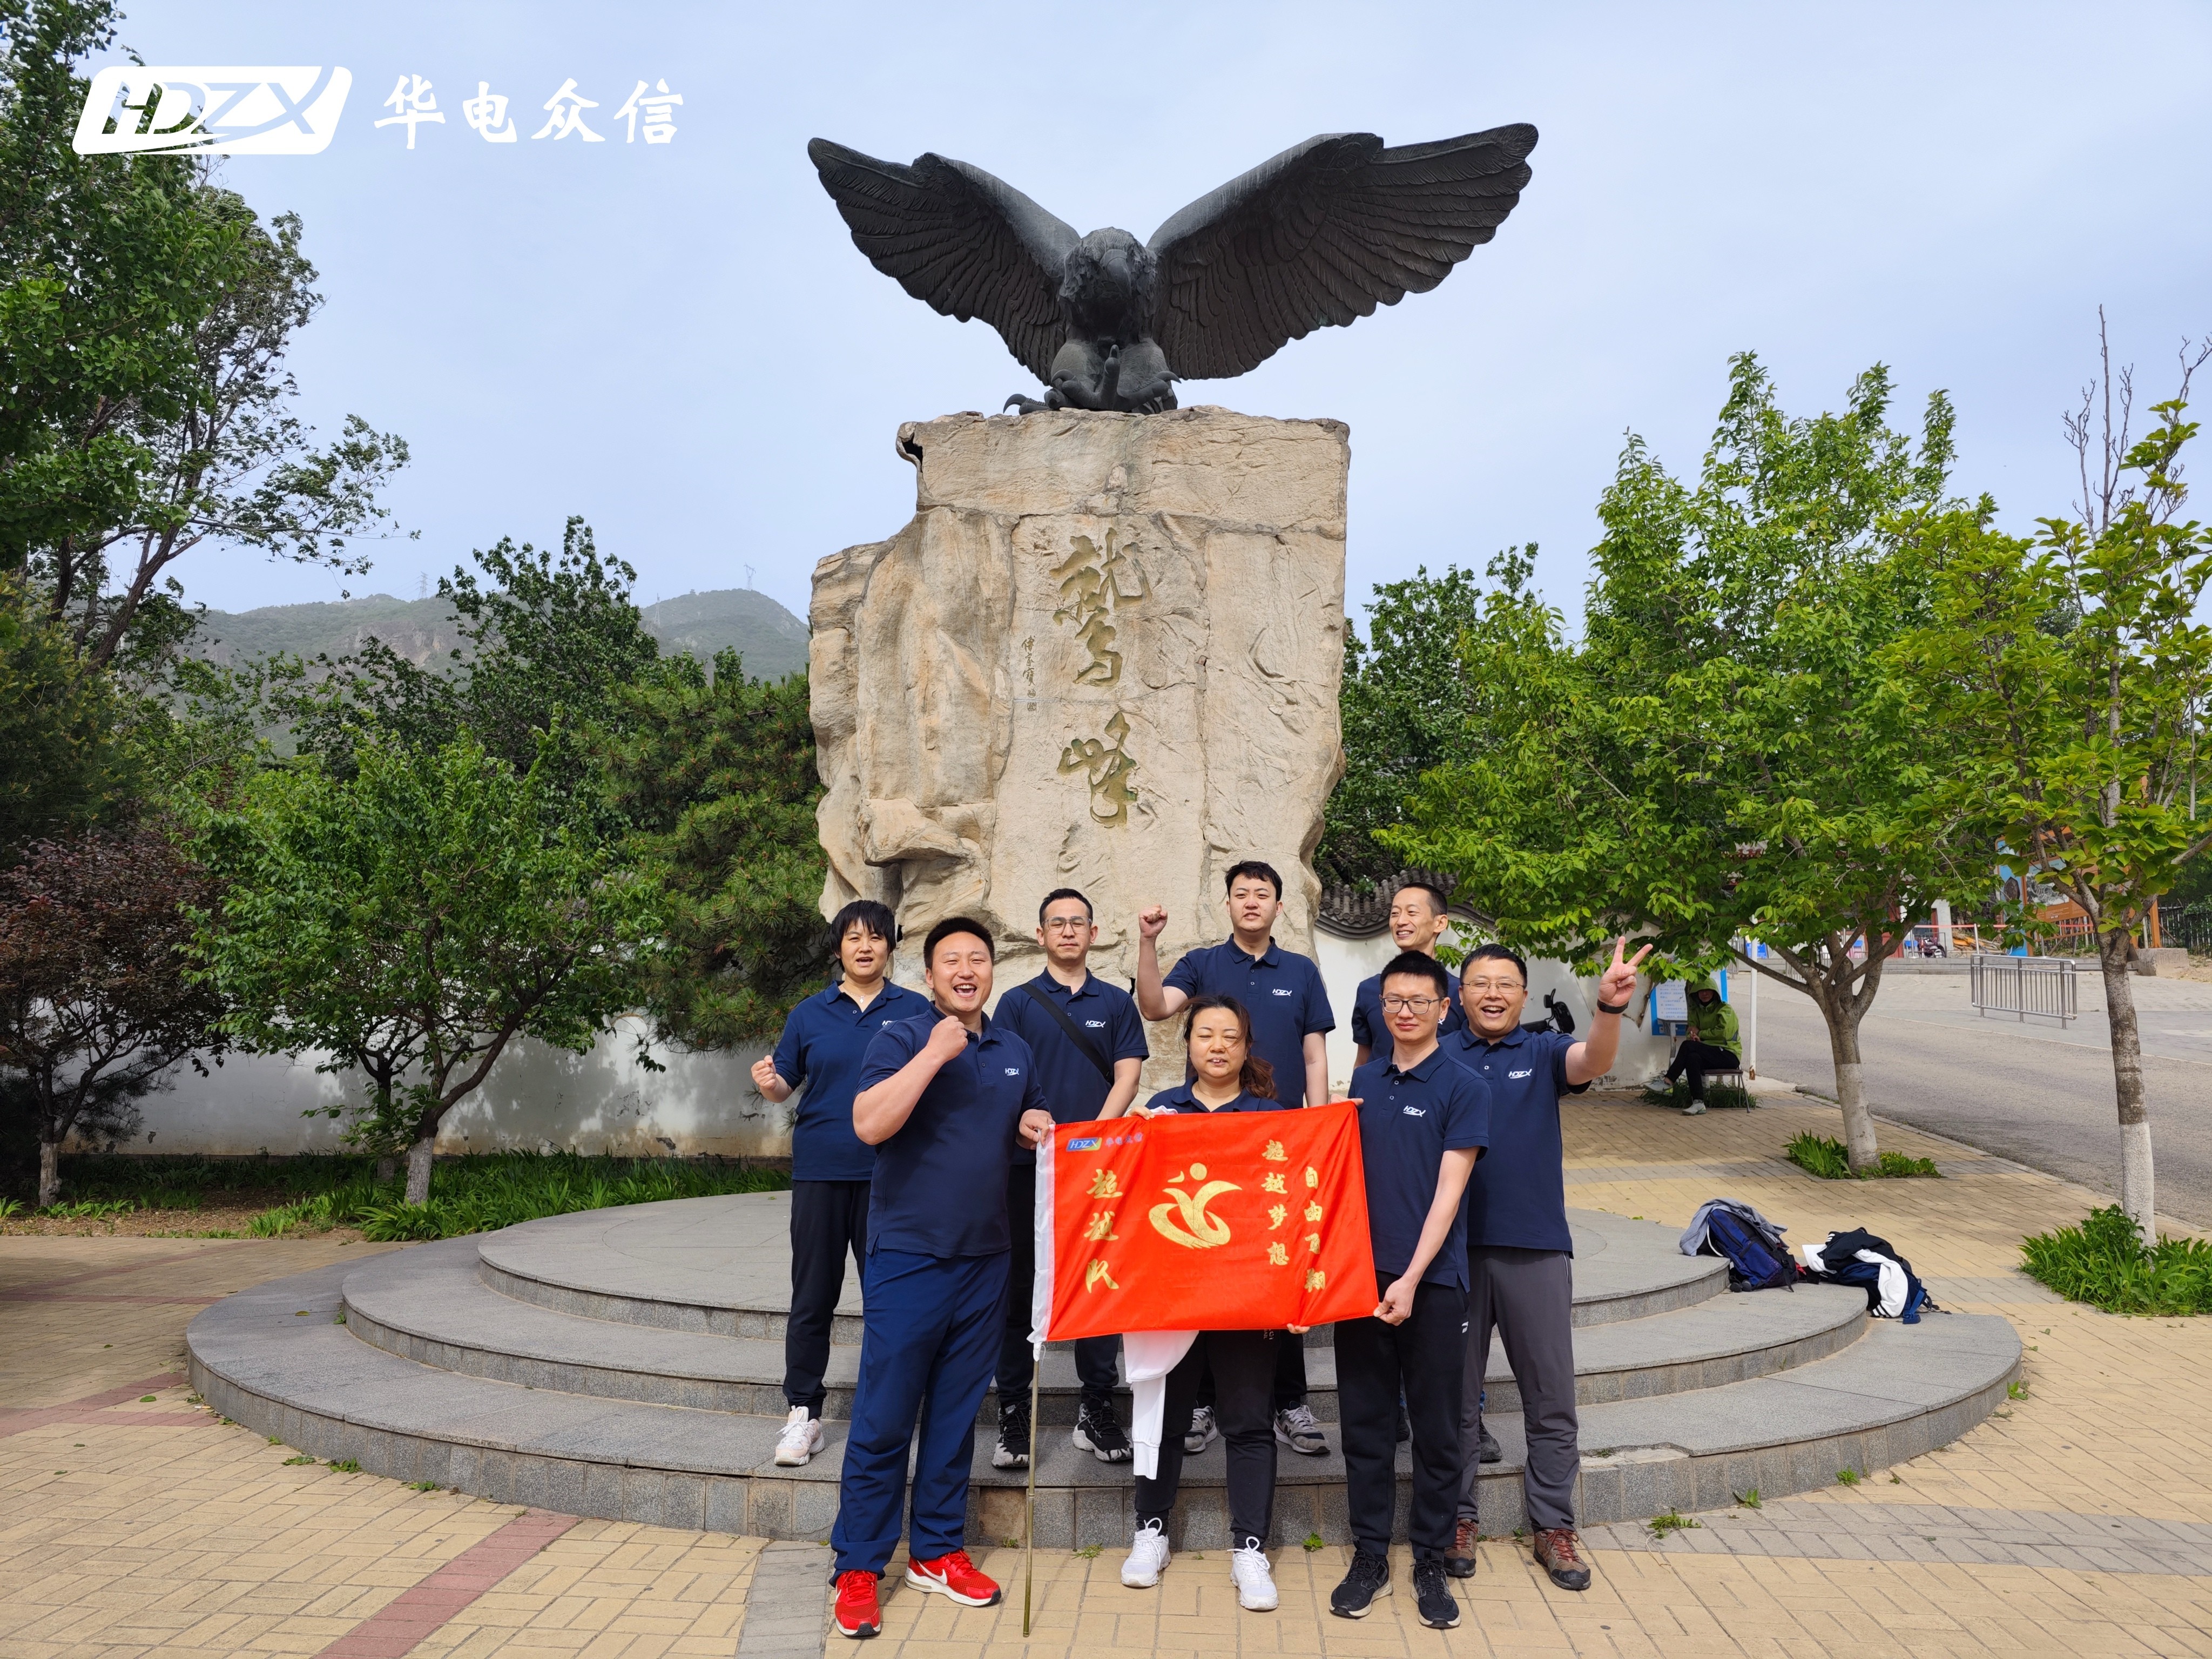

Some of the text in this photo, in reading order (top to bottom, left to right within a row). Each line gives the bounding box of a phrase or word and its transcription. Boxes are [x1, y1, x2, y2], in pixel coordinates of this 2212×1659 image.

[1272, 988, 1292, 996] HDZX
[1085, 1020, 1106, 1028] HDZX
[1005, 1068, 1020, 1076] HDZX
[1508, 1068, 1533, 1078] HDZX
[1069, 1139, 1098, 1149] HDZX
[1261, 1139, 1290, 1265] 超越梦想
[1083, 1168, 1124, 1294] 超越队
